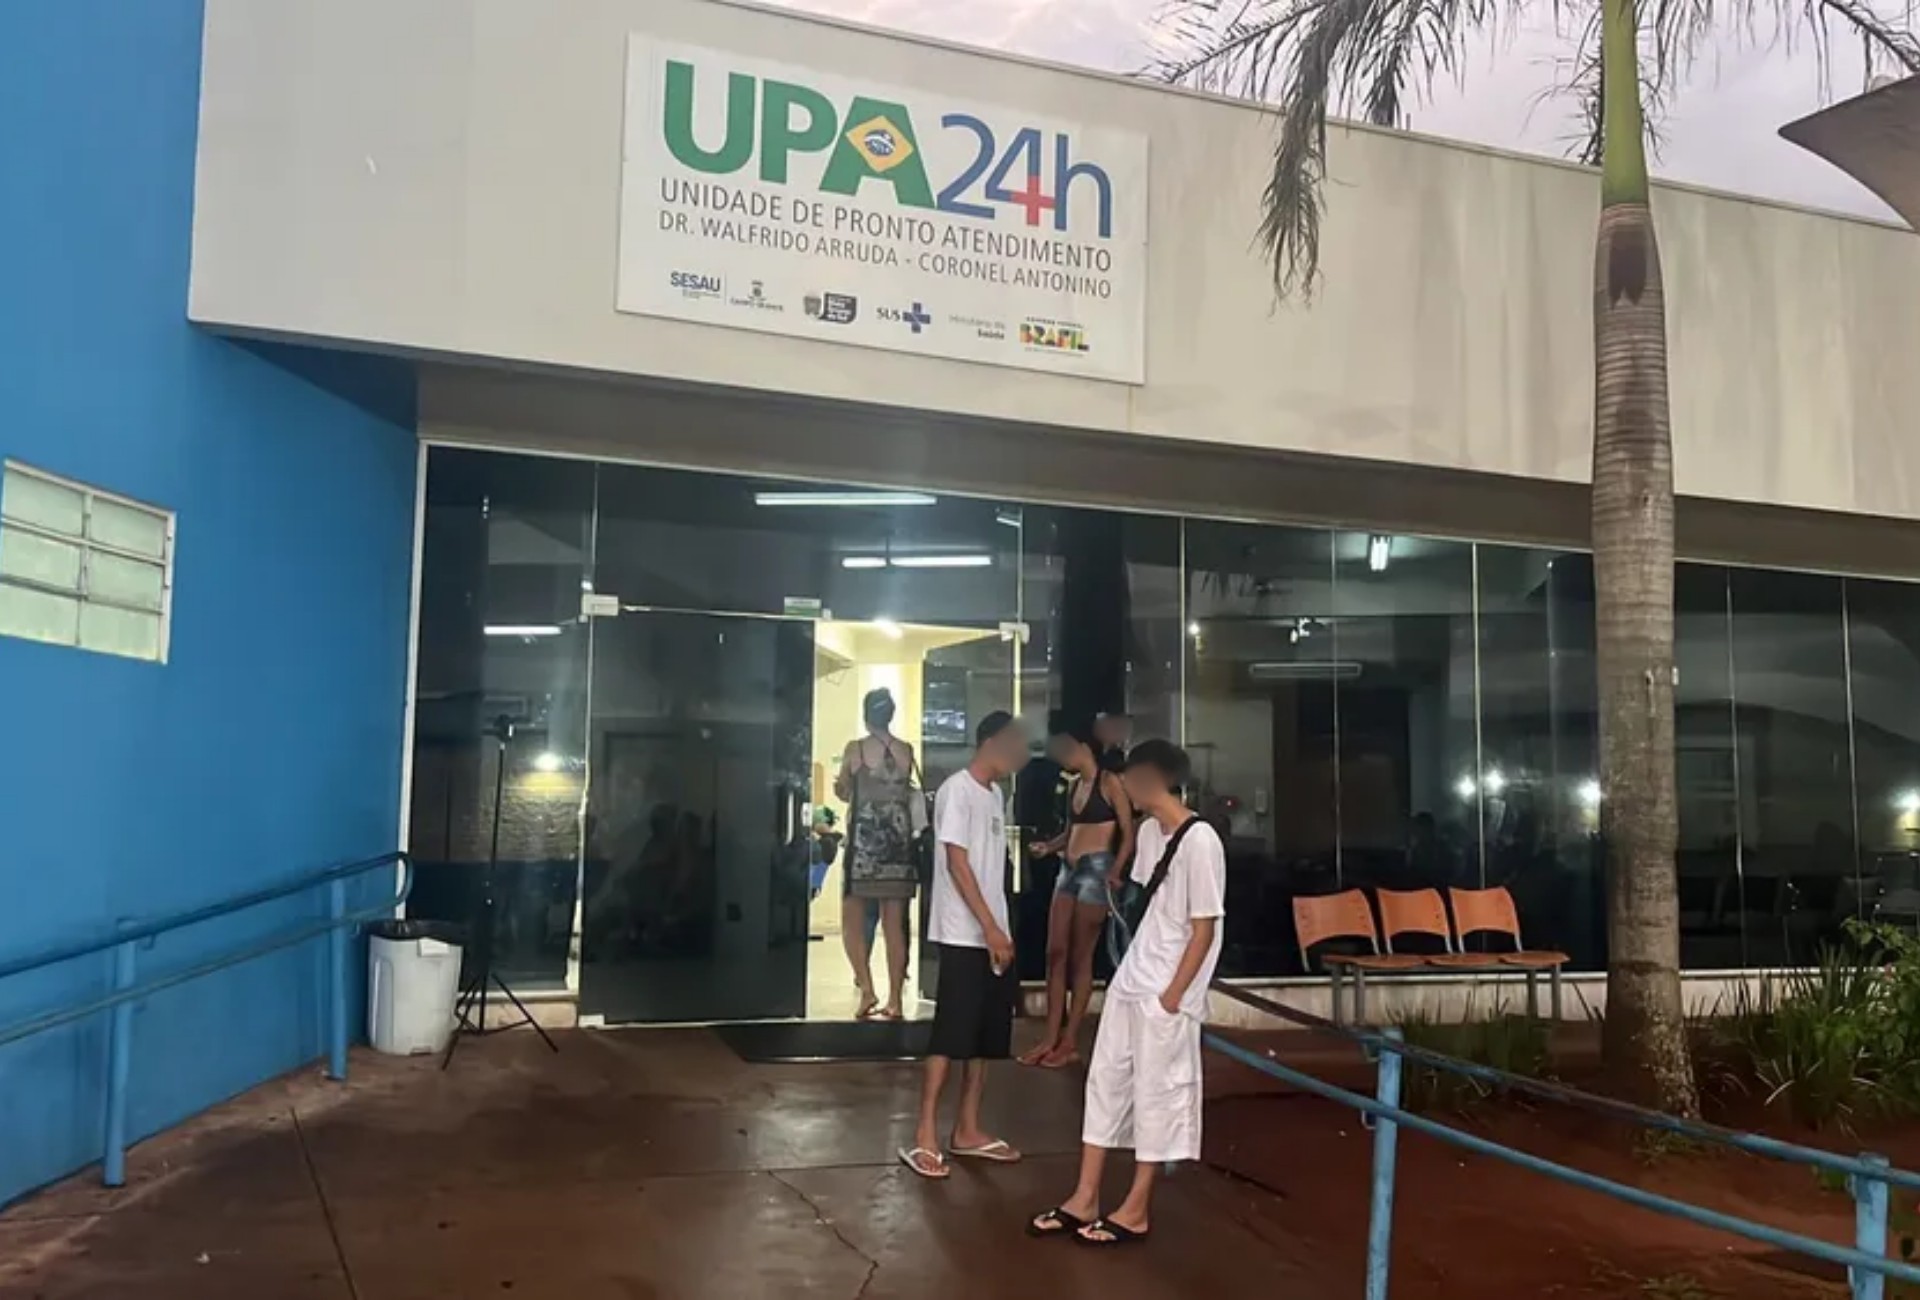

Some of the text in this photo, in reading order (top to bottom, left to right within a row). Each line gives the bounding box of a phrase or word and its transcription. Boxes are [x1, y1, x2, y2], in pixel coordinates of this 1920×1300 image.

[664, 59, 1112, 239] UPA 24h
[659, 210, 695, 235] DR.
[701, 217, 809, 253] WALFRIDO
[814, 236, 898, 266] ARRUDA
[918, 252, 1009, 284] CORONEL
[1013, 267, 1112, 299] ANTONINO
[661, 177, 1111, 273] UNIDADE DE PRONTO ATENDIMENTO
[670, 271, 720, 292] SESAU
[876, 307, 901, 322] SUS
